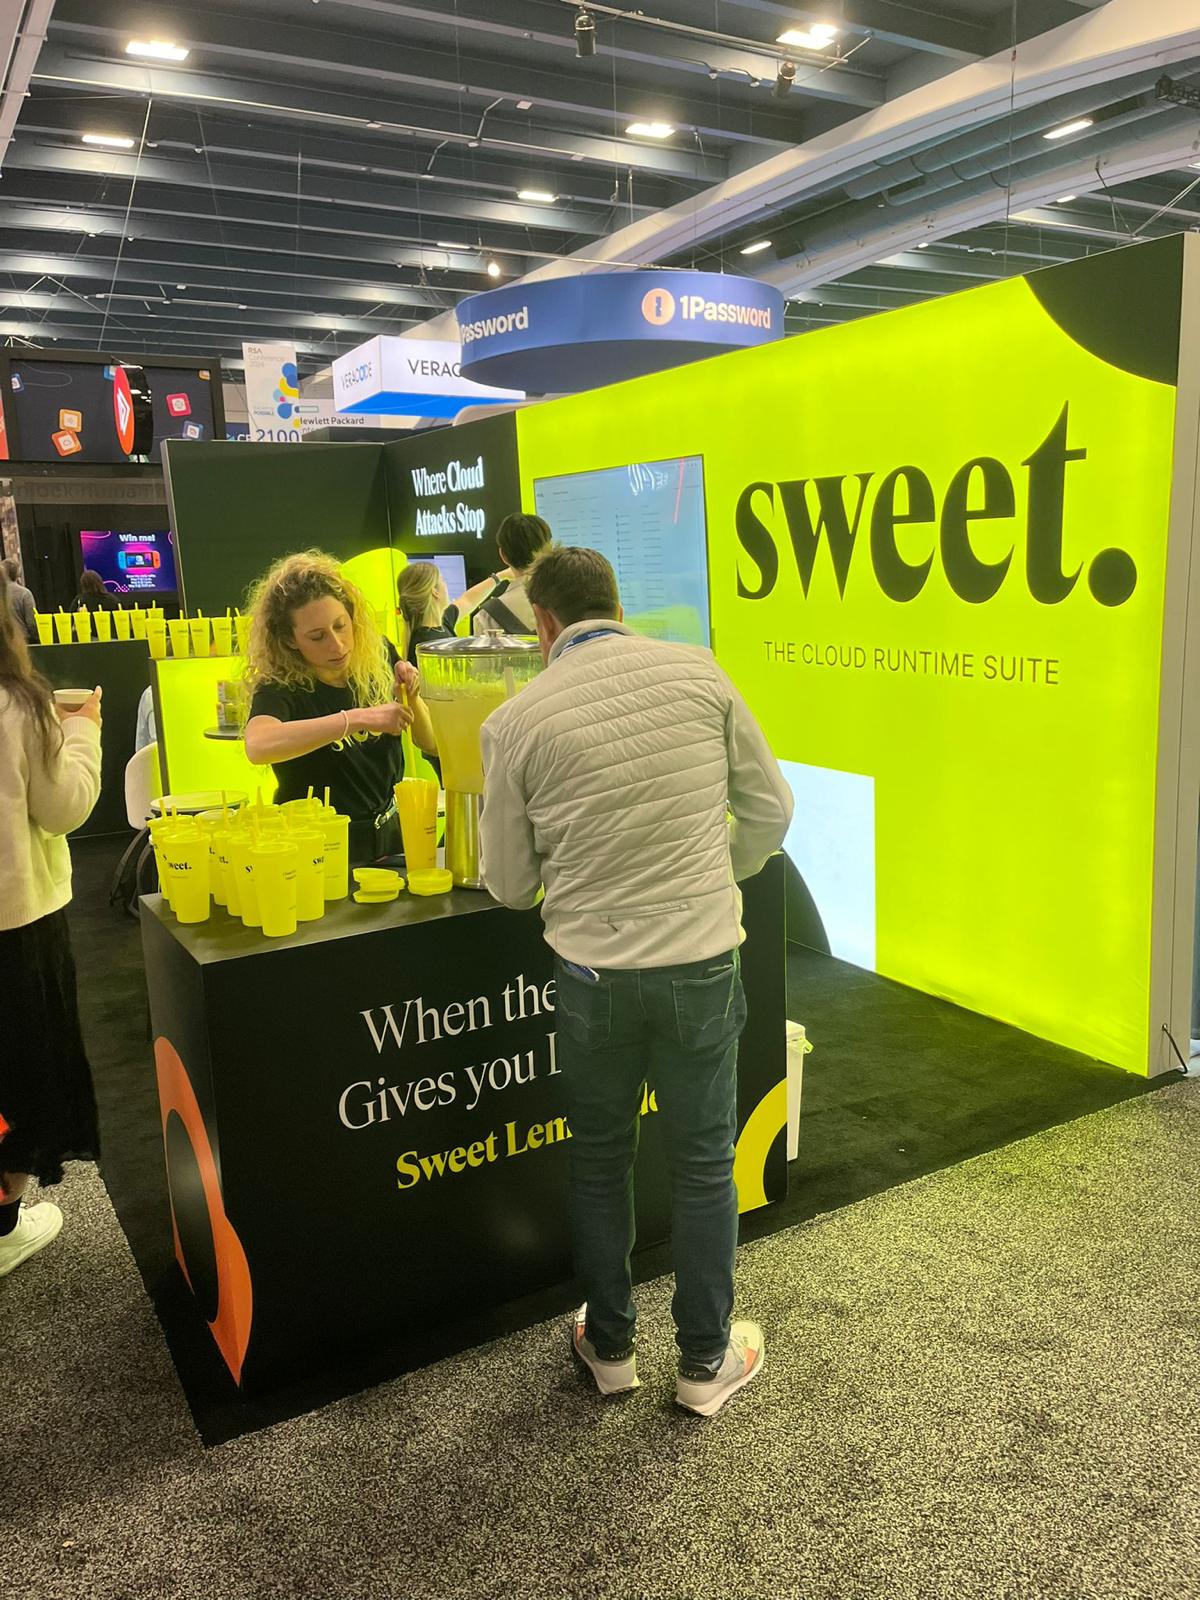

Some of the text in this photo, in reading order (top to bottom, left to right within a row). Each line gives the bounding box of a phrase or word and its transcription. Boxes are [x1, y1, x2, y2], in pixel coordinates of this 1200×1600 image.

[680, 295, 771, 329] 1Password
[407, 359, 461, 378] VERAC
[255, 429, 300, 442] 2100
[331, 417, 365, 425] Packard
[411, 455, 485, 497] Where Cloud
[415, 502, 486, 539] Attacks Stop
[734, 399, 1138, 608] sweet.
[119, 533, 156, 542] Win me!
[763, 640, 1060, 685] THE CLOUD RUNTIME SUITE
[168, 861, 192, 870] weet.
[359, 995, 493, 1054] When
[501, 973, 556, 1022] the
[338, 1077, 457, 1129] Gives
[464, 1049, 537, 1111] you
[396, 1130, 499, 1189] Sweet
